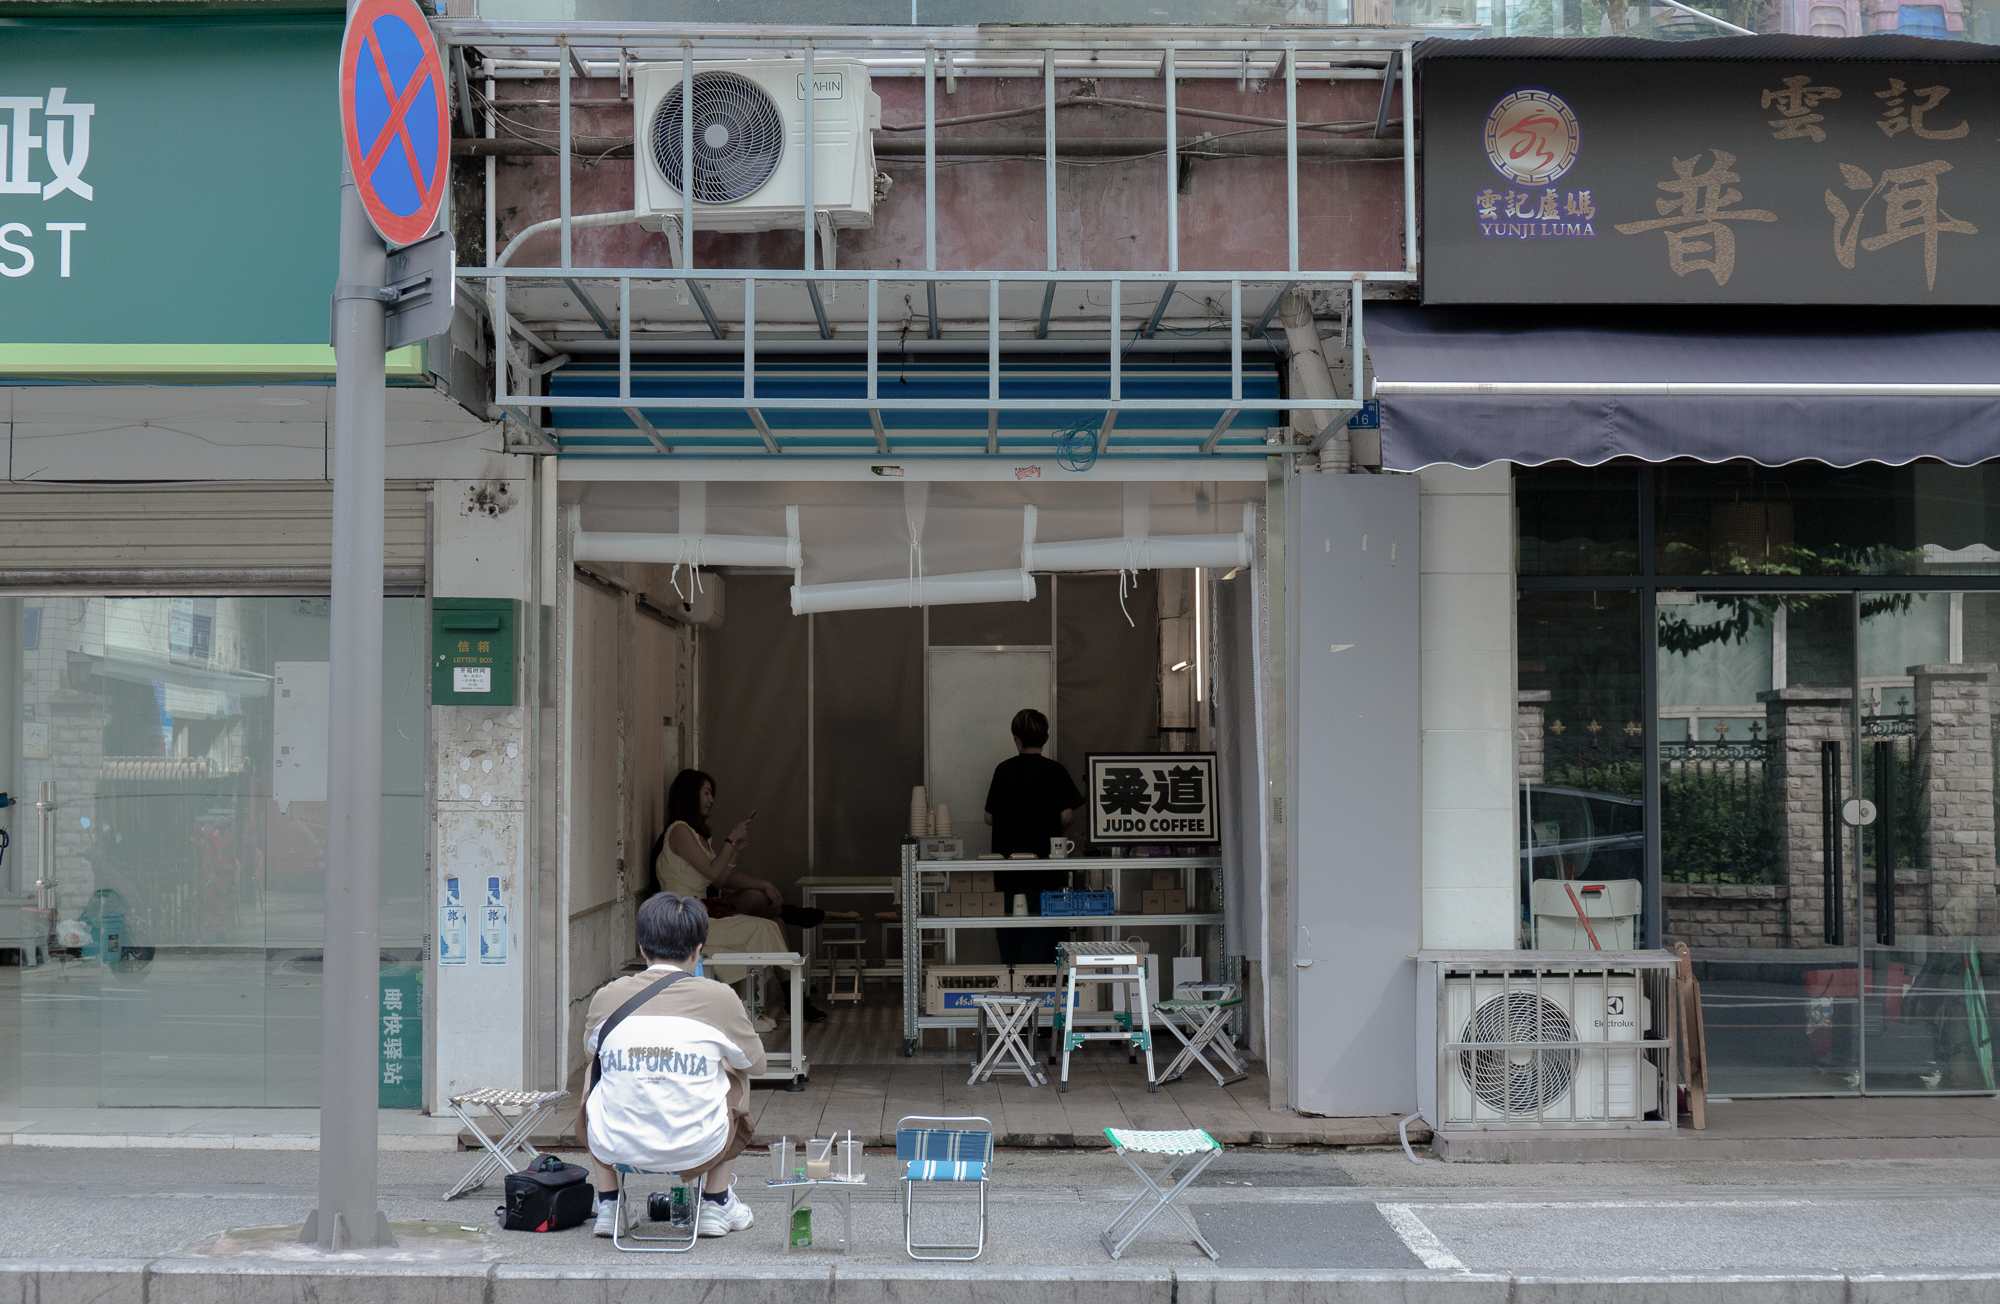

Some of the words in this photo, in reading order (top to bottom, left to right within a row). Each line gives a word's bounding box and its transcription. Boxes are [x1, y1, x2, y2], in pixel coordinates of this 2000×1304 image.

[1476, 188, 1596, 221] 雲記盧媽
[1481, 223, 1536, 239] YUNJI
[1540, 223, 1595, 236] LUMA
[1613, 148, 1979, 292] 普洱
[0, 222, 87, 278] ST
[458, 641, 490, 653] 信箱
[1100, 764, 1207, 815] 柔道
[1103, 818, 1146, 832] JUDO
[1149, 818, 1205, 832] COFFEE
[383, 988, 403, 1085] 邮快驿站
[600, 1049, 708, 1077] CALIFORNIA
[628, 1046, 674, 1058] AWESOME
